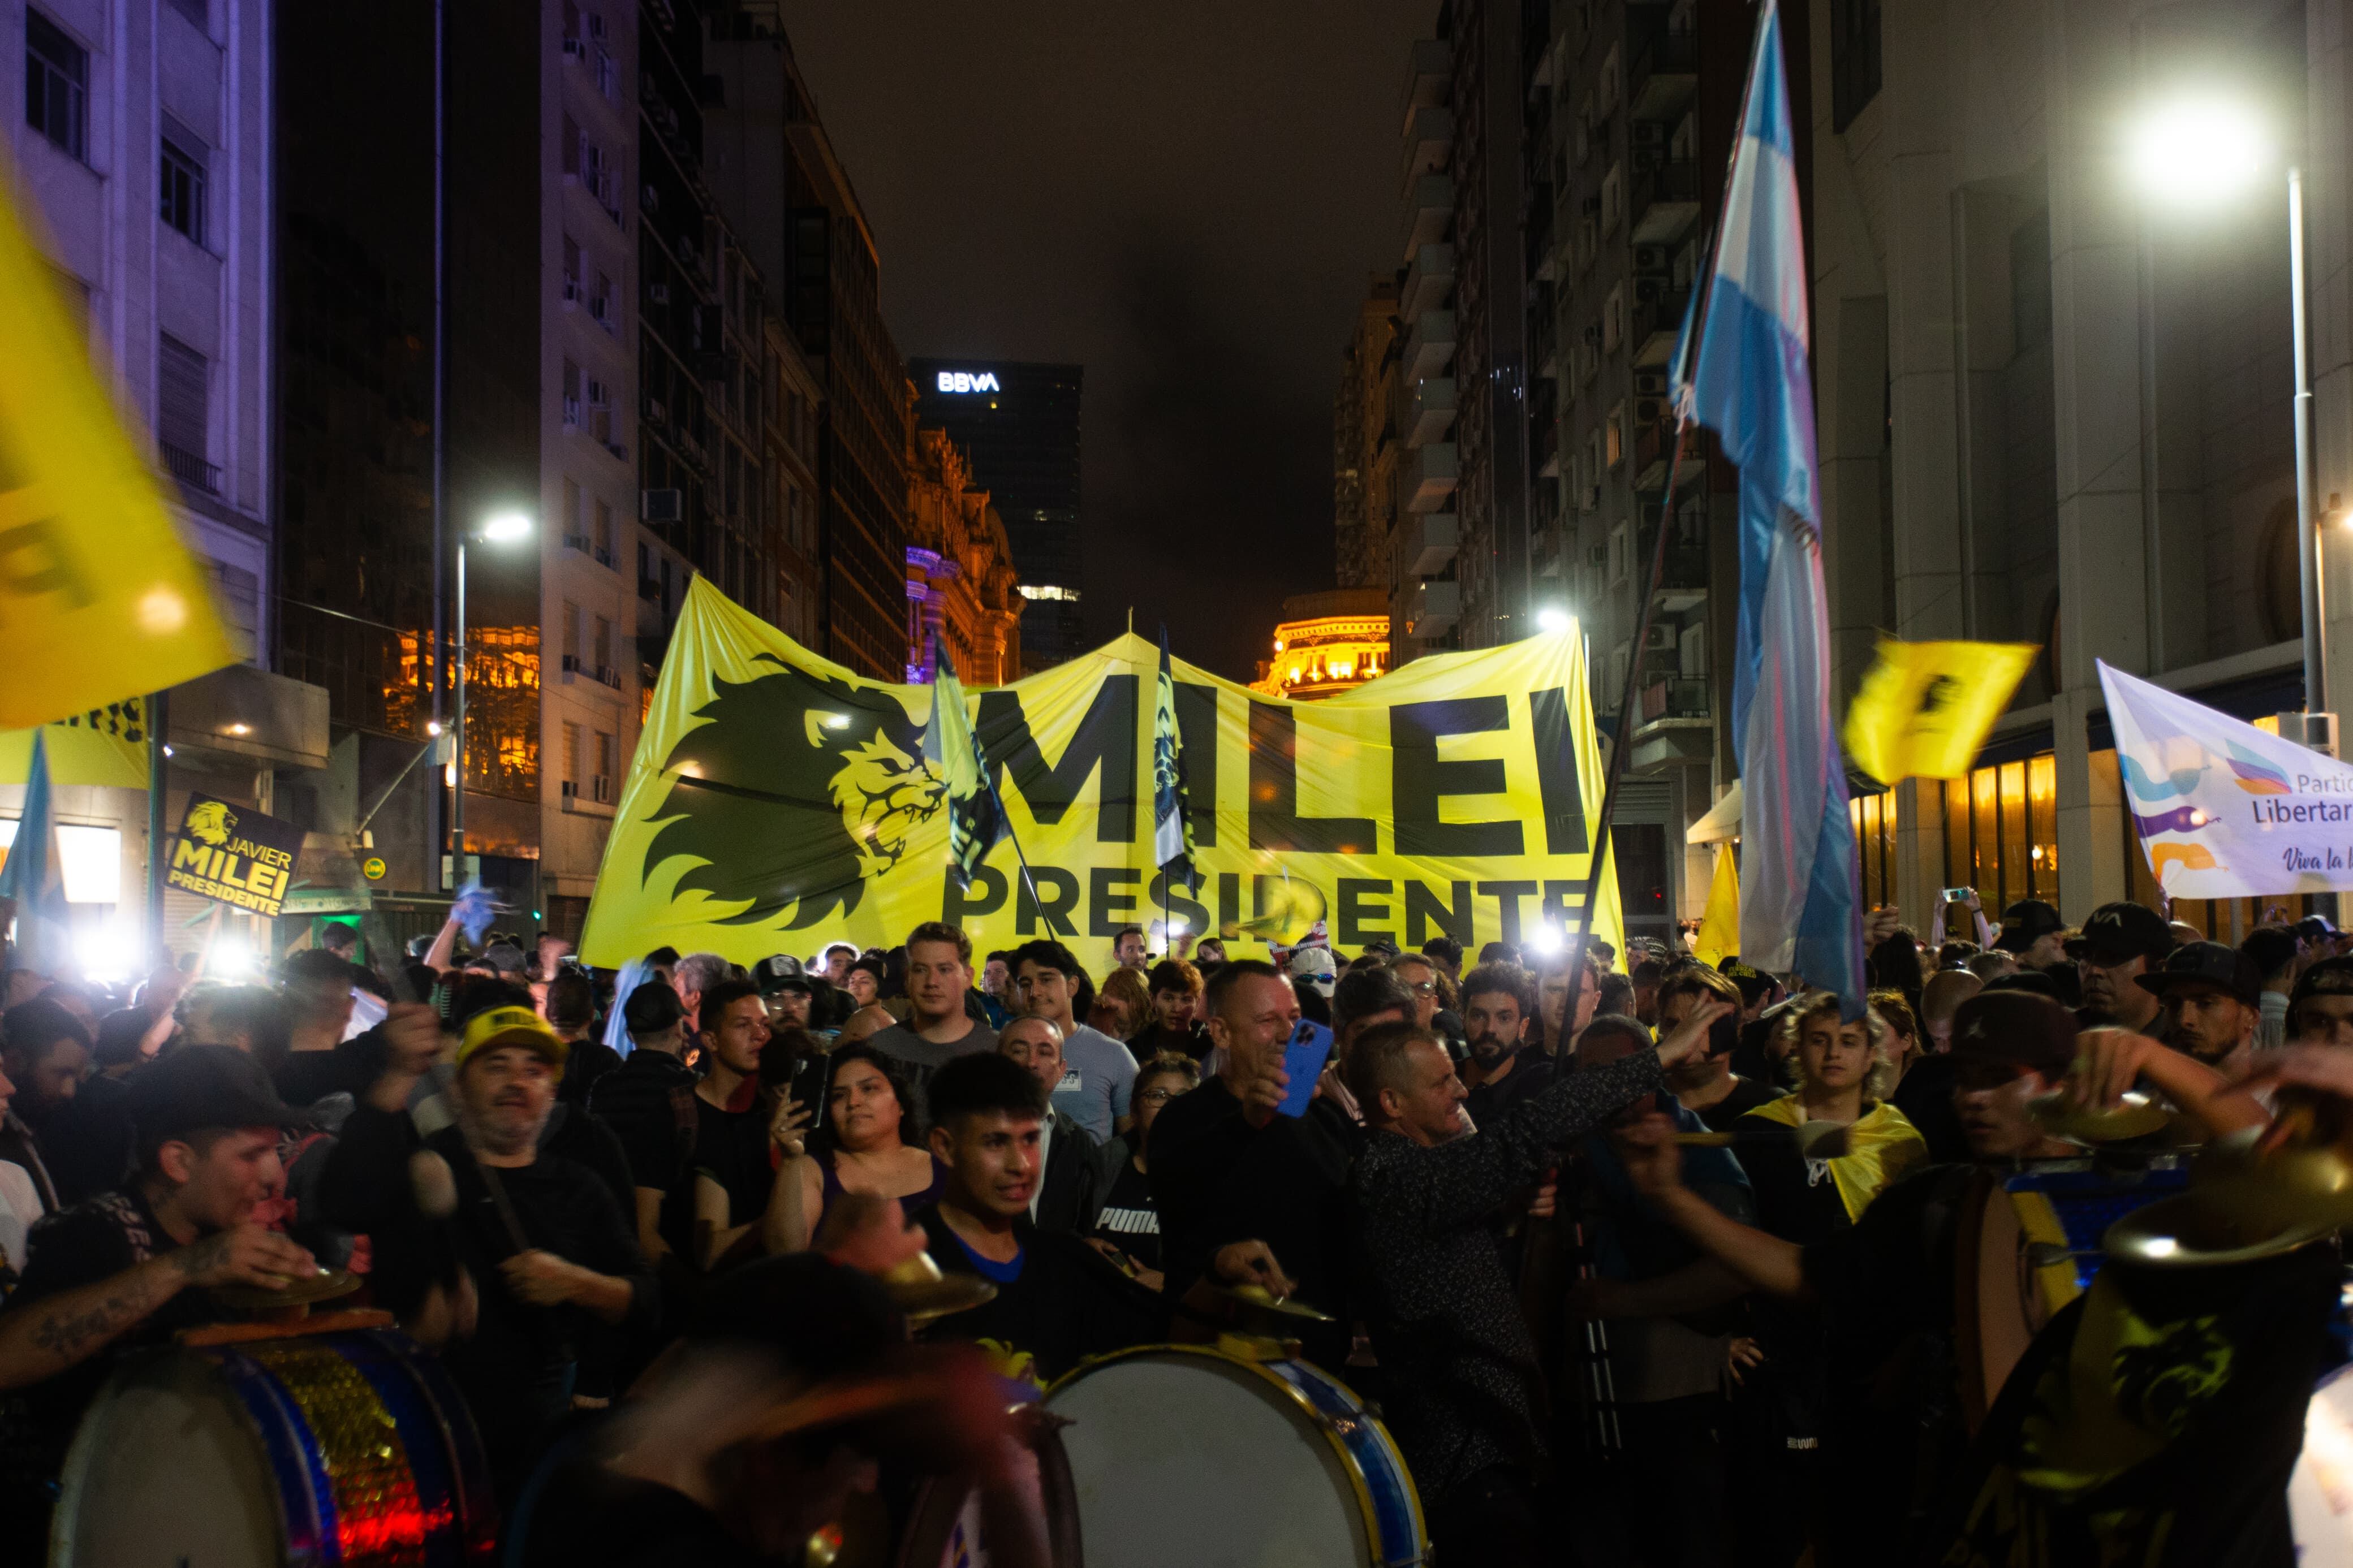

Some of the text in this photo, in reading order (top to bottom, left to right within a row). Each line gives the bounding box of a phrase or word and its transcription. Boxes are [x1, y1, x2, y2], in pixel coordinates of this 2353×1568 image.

[938, 372, 999, 392] BBVA
[971, 675, 1588, 856] MILEI
[227, 837, 292, 869] JAVIER
[2283, 847, 2321, 871] Viva
[2327, 847, 2342, 870] la
[173, 839, 290, 900] MILEI
[168, 870, 281, 917] PRESIDENTE
[1095, 1207, 1160, 1234] PUMA
